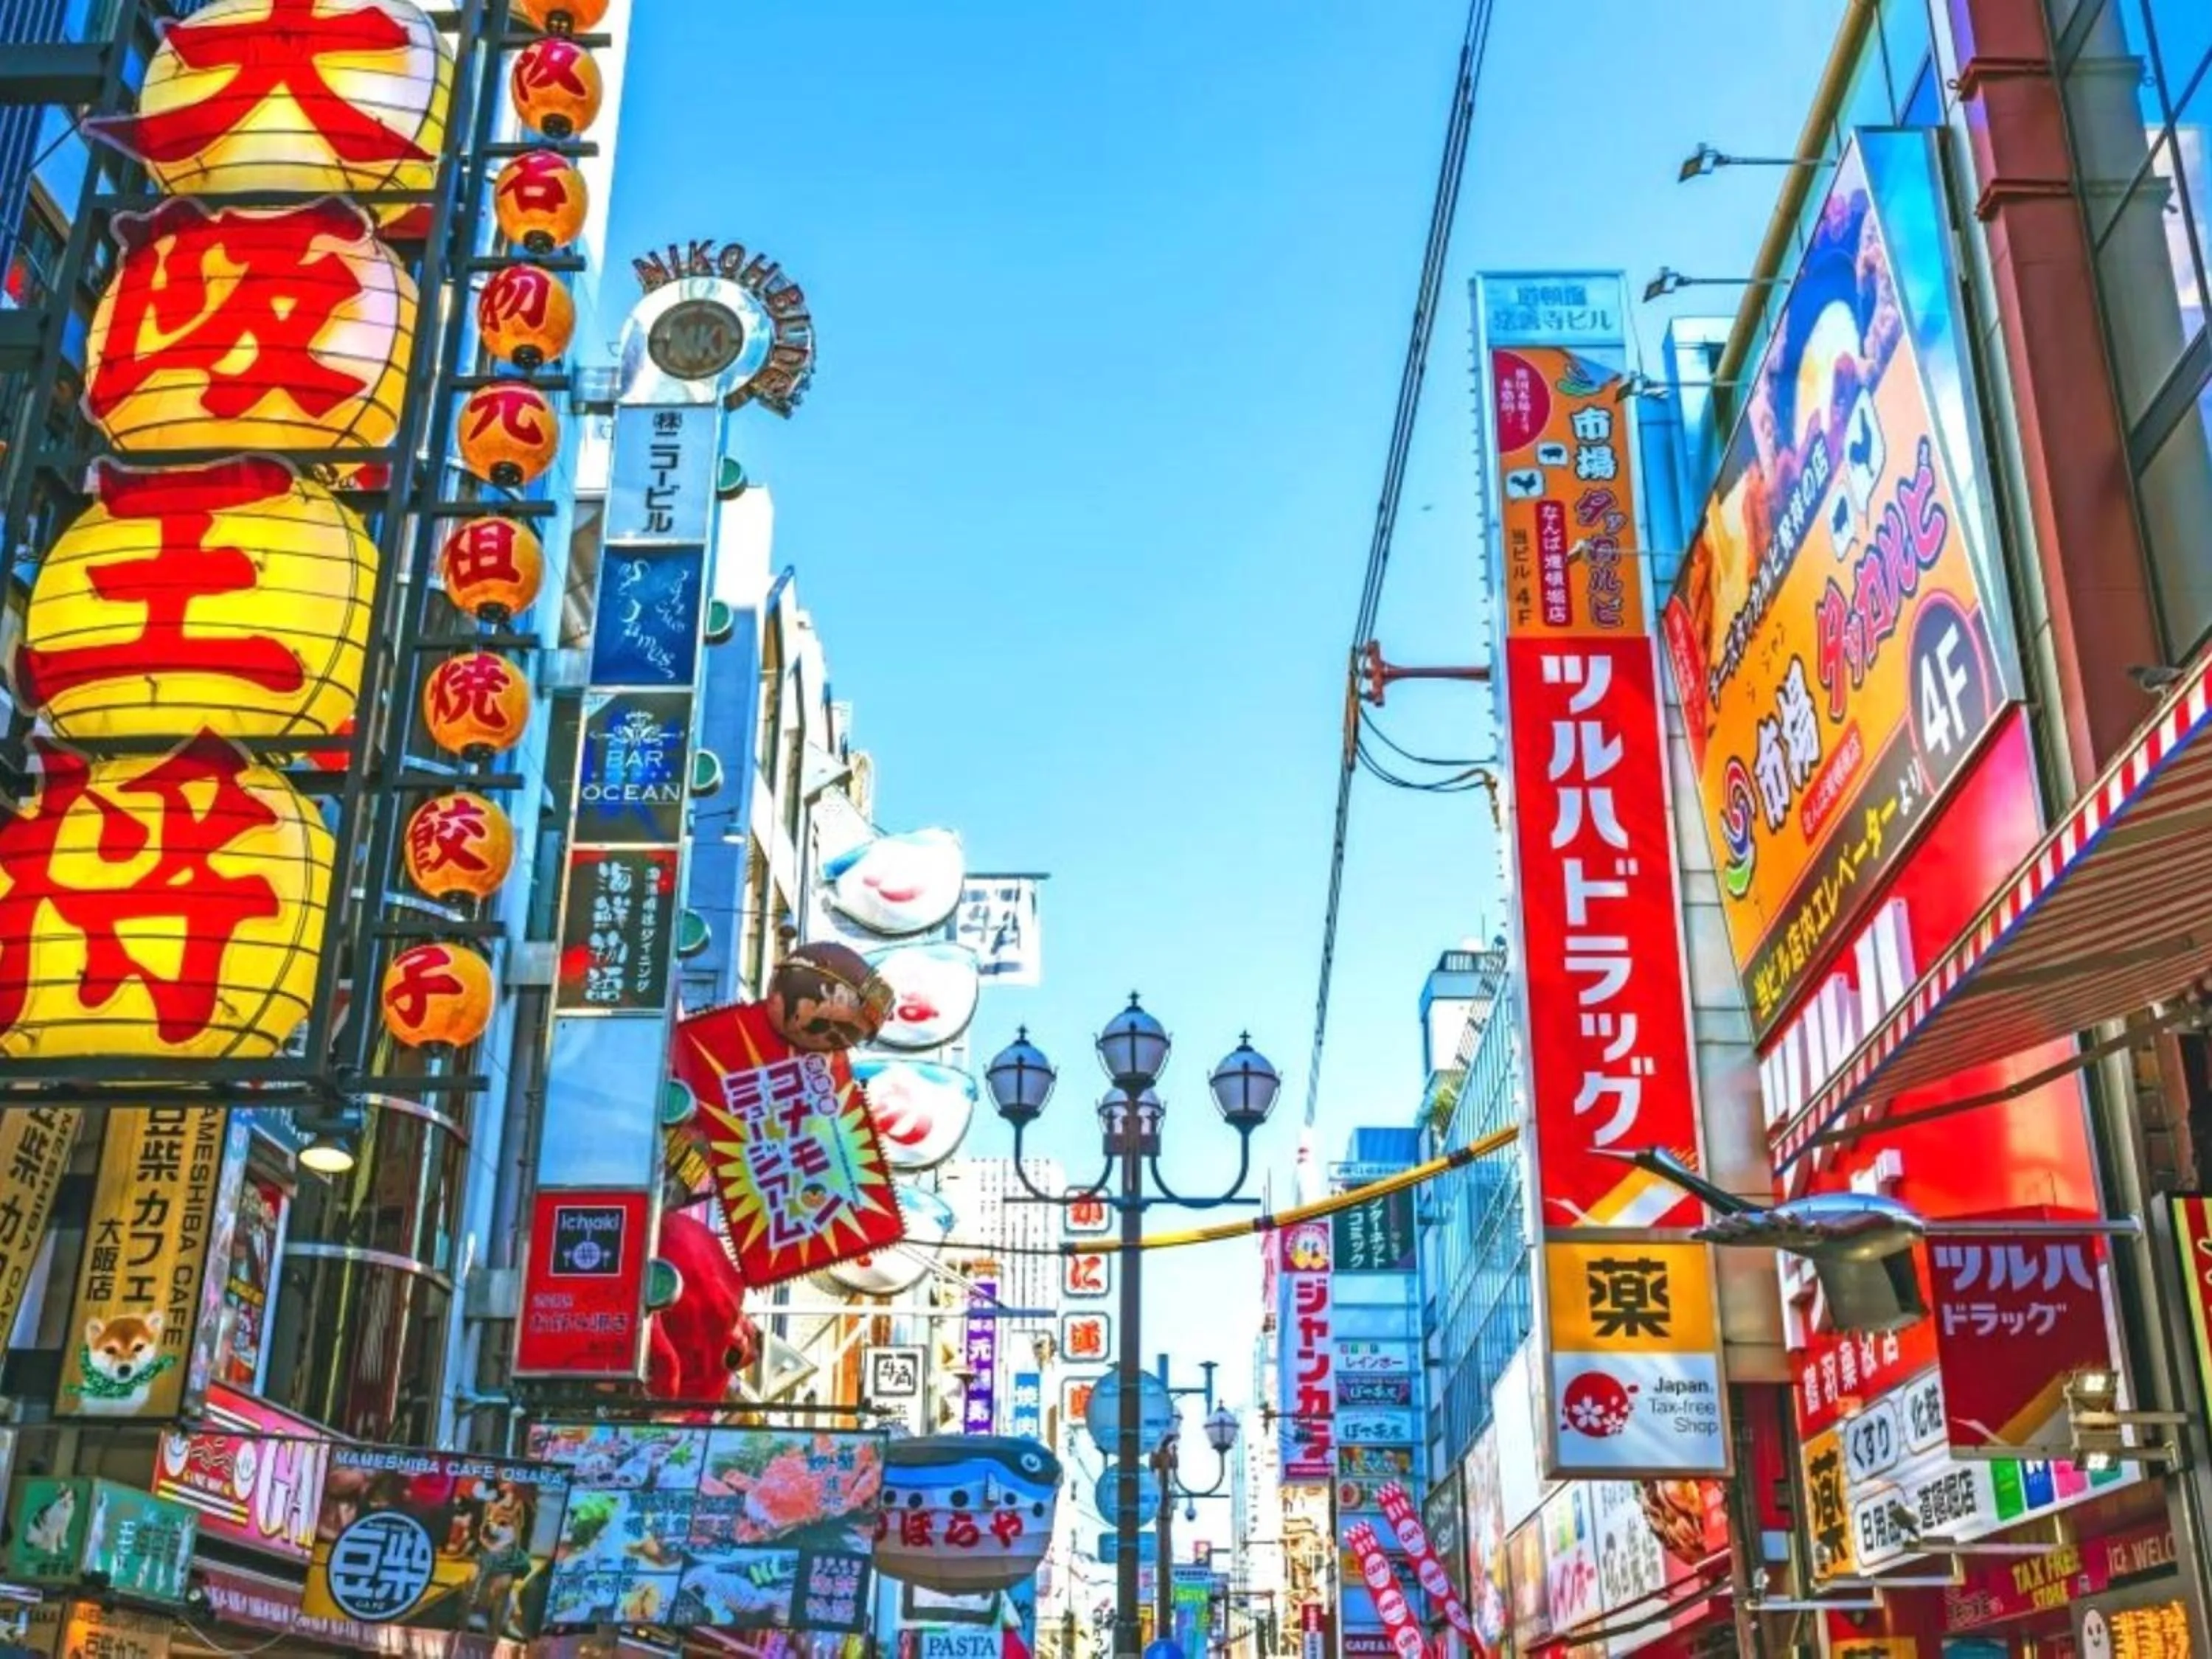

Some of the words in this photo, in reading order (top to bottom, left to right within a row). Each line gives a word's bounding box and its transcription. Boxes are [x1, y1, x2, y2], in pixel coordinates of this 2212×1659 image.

[1920, 622, 1968, 757] 4F
[606, 750, 664, 768] BAR
[582, 784, 681, 802] OCEAN
[1540, 655, 1657, 1147] ツルハドラッグ
[86, 1218, 125, 1301] 大阪店
[1934, 1244, 2094, 1292] ツルハ
[163, 1265, 195, 1346] CAFE
[1587, 1257, 1672, 1338] 薬
[1941, 1302, 2067, 1337] ドラッグ
[1649, 1398, 1717, 1416] Tax-free
[1674, 1417, 1719, 1439] Shop
[1852, 1415, 1891, 1470] くすり
[335, 1450, 439, 1475] MAMESHIBA
[445, 1461, 495, 1479] CAFE
[2011, 1556, 2045, 1595] TAX
[928, 1635, 998, 1657] PASTA
